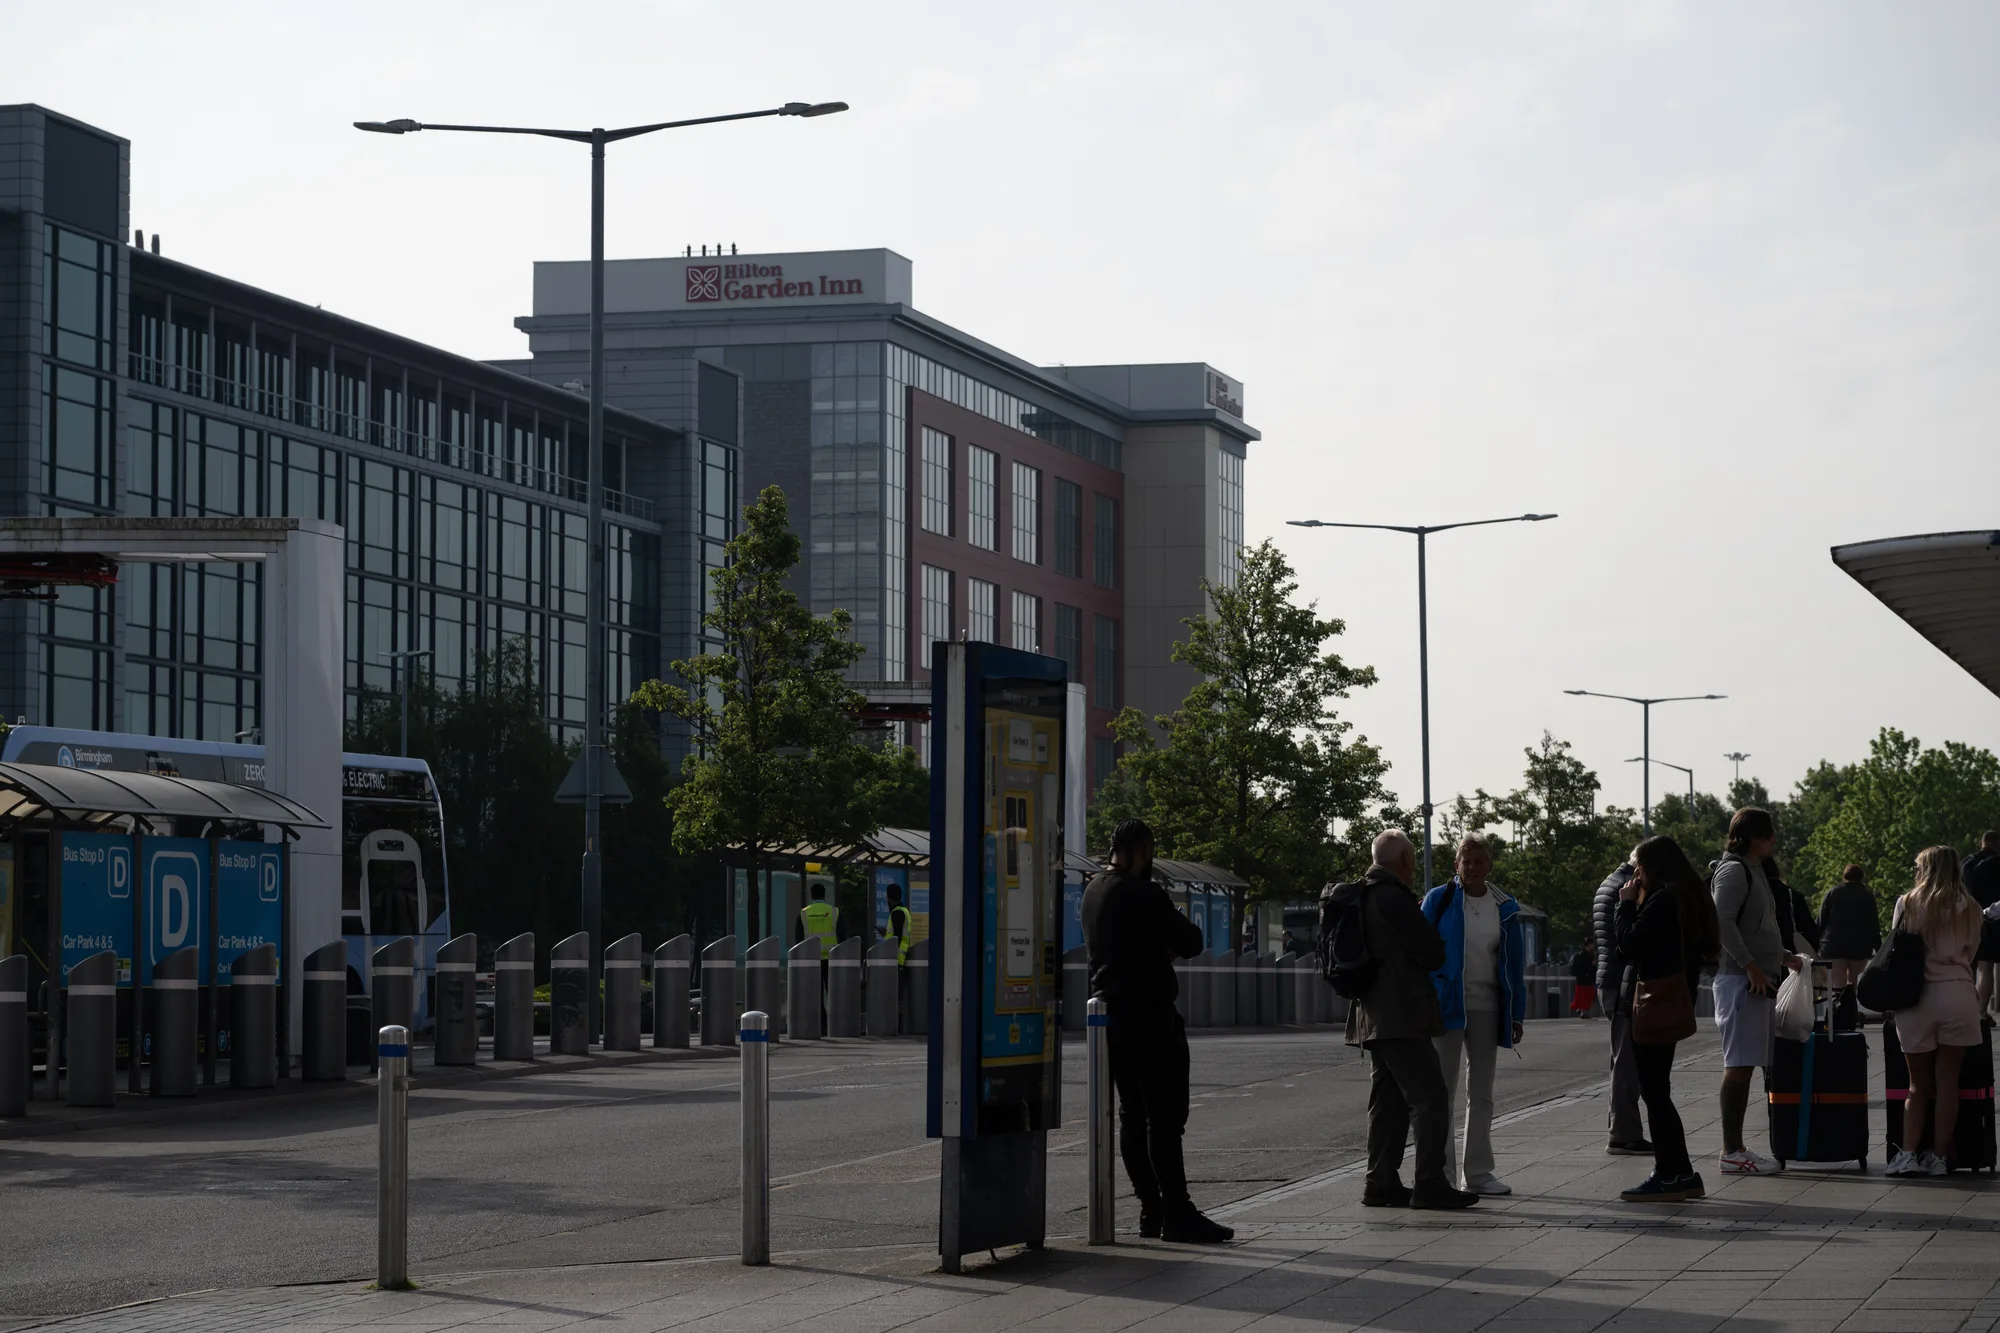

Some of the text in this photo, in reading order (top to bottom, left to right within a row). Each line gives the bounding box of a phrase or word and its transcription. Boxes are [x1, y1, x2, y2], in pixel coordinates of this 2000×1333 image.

[724, 264, 783, 279] Hilton
[723, 275, 863, 301] Garden Inn
[75, 748, 113, 766] Birmingham
[349, 771, 387, 790] ELECTRIC
[63, 846, 104, 865] Bus Stop D
[219, 853, 256, 871] Bus Stop D
[114, 856, 126, 888] D
[264, 862, 276, 892] D
[162, 874, 189, 947] D
[63, 934, 113, 949] Car Park 4 & 5
[218, 934, 231, 949] Car
[231, 935, 246, 949] Park
[246, 935, 252, 948] 4
[252, 936, 258, 949] &
[218, 962, 228, 973] Car
